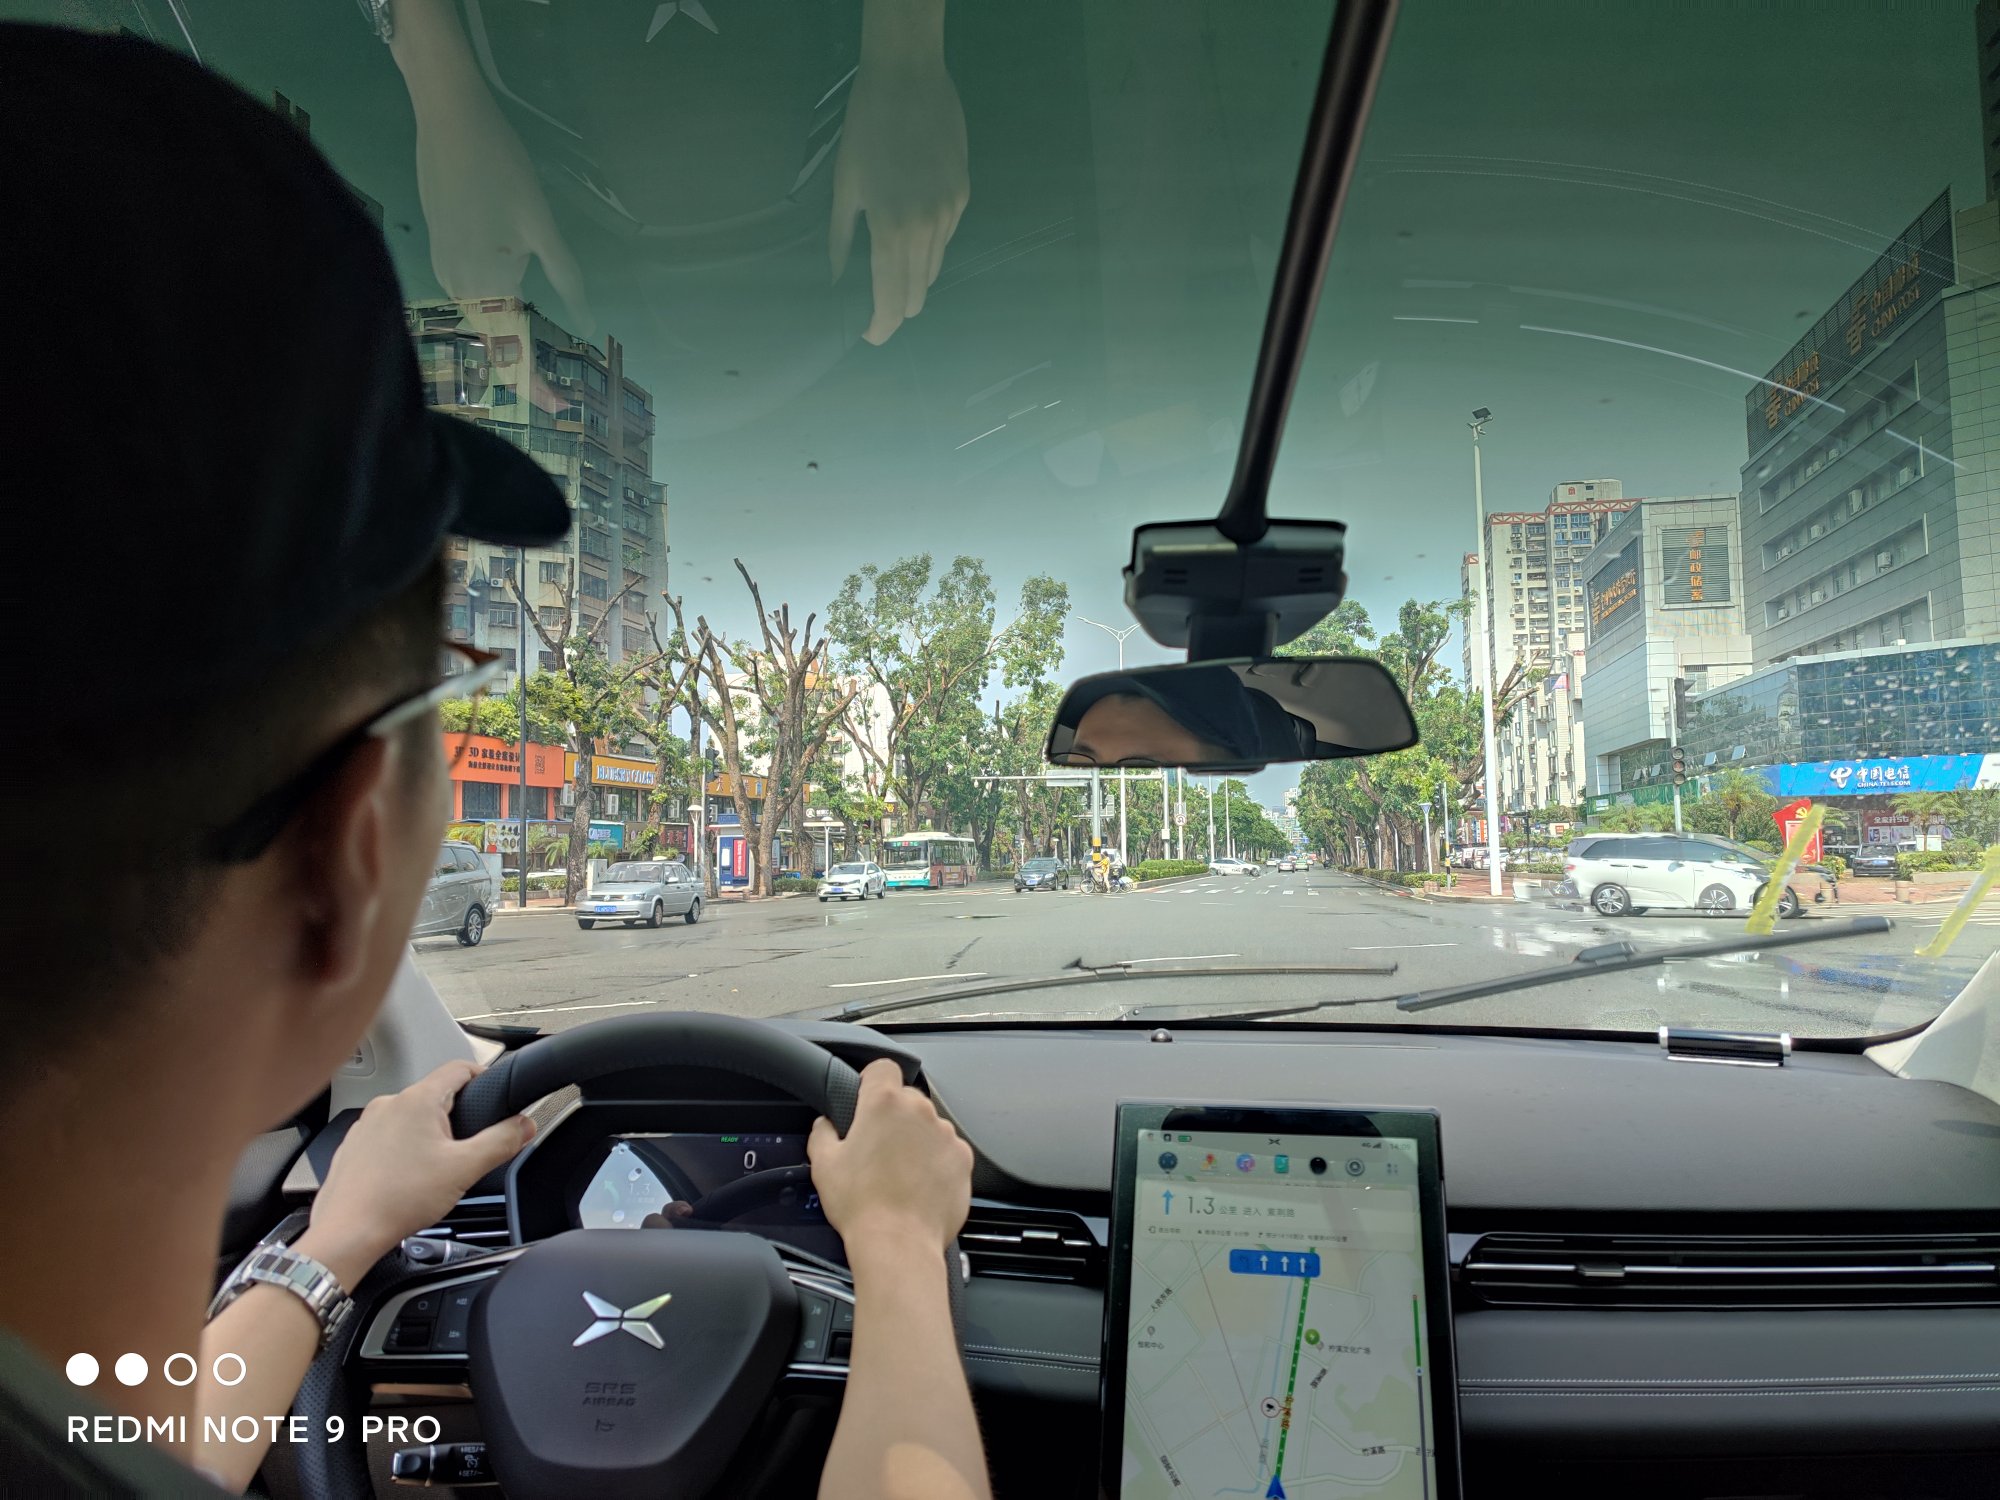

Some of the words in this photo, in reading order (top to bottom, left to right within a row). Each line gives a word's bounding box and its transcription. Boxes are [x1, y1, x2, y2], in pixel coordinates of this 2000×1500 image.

[1857, 765, 1909, 782] 中国电信
[744, 1150, 756, 1169] 0
[1187, 1197, 1215, 1215] 1.3
[1219, 1206, 1238, 1216] 公里
[1242, 1207, 1261, 1217] 进入
[582, 1397, 637, 1406] AIRBAG
